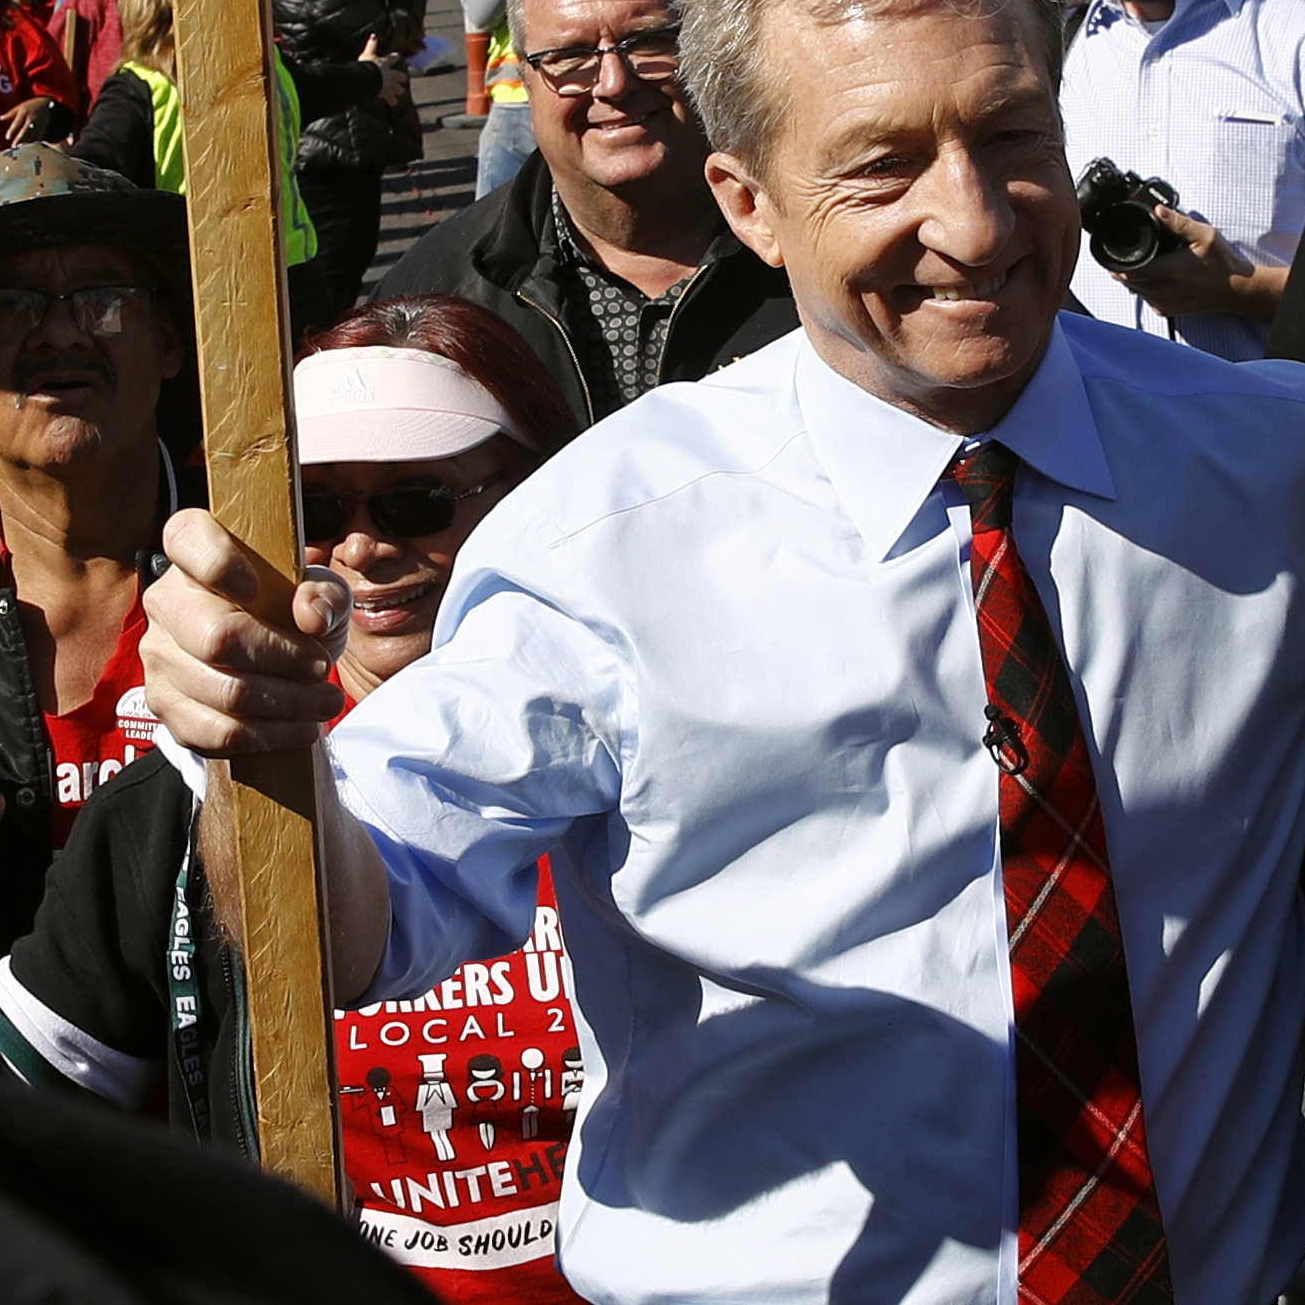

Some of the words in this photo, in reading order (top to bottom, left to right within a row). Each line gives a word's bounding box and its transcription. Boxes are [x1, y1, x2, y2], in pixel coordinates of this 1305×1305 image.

[350, 1013, 515, 1050] LOCAL
[404, 1230, 449, 1252] JOB
[458, 1219, 553, 1256] SHOULD
